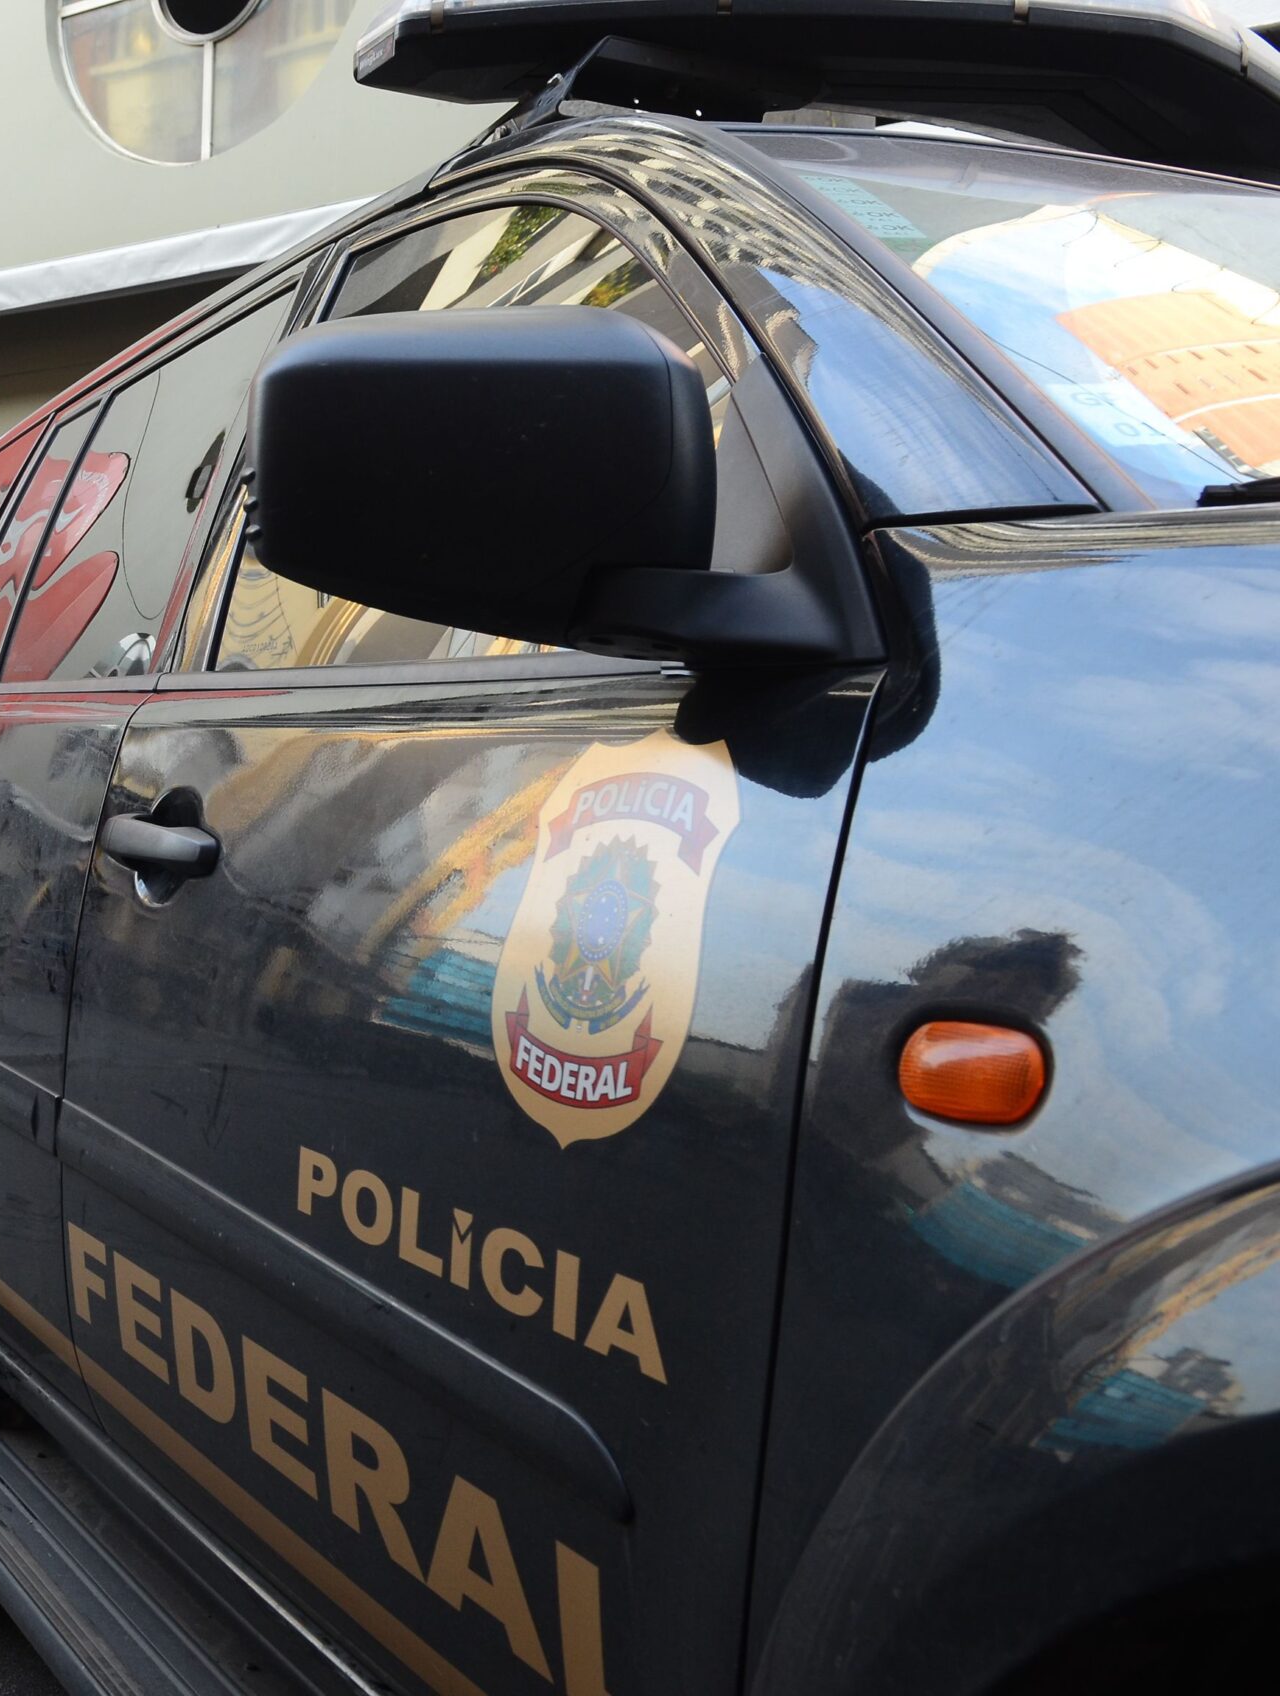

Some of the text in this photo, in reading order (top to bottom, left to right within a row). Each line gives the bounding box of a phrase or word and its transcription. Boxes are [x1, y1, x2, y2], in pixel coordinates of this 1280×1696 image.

[571, 779, 695, 832] POLÍCIA
[515, 1036, 633, 1102] FEDERAL
[297, 1145, 668, 1386] POLÍCIA
